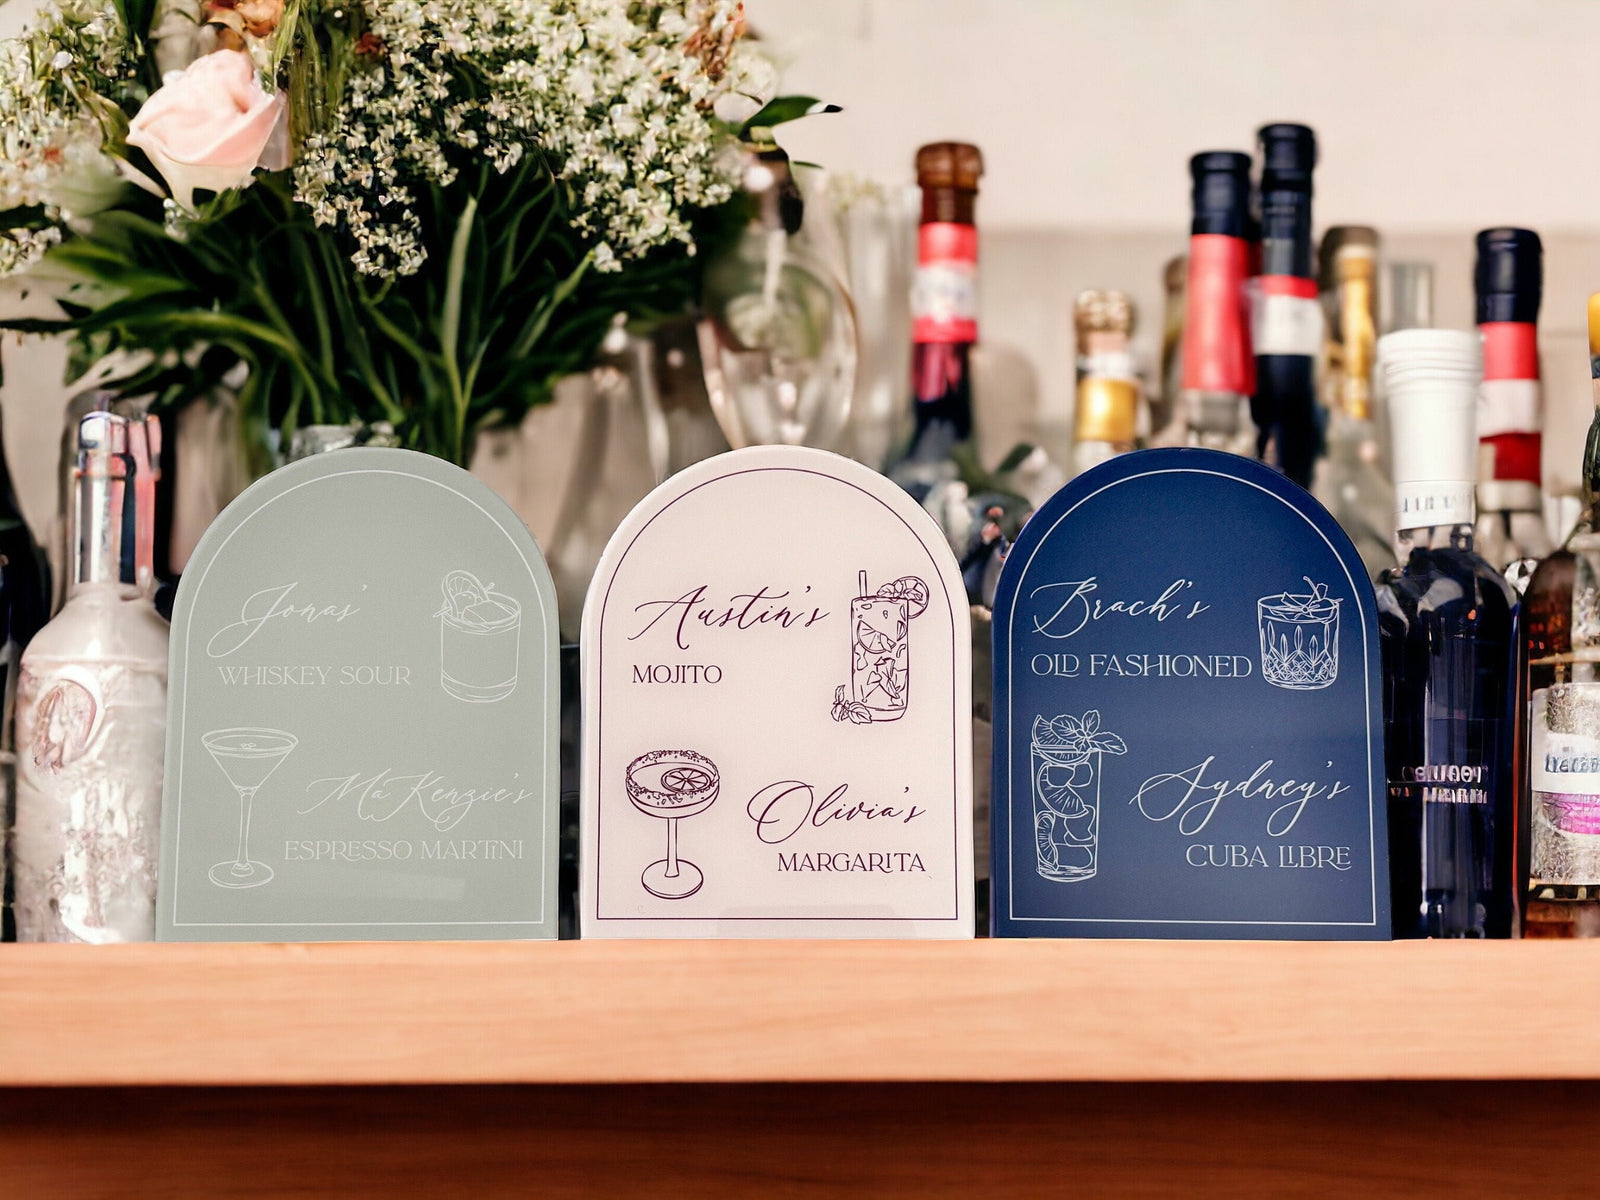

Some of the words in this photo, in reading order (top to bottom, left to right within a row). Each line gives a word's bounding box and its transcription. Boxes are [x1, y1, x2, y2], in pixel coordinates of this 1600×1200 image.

[206, 581, 368, 658] Jonas'
[627, 585, 831, 650] Austin's
[1030, 576, 1210, 639] Brach's
[218, 665, 332, 686] WHISKEY
[340, 665, 412, 686] SOUR
[632, 664, 723, 684] MOJITO
[1031, 653, 1080, 678] OLD
[1089, 654, 1253, 678] FASHIONED
[1128, 755, 1351, 837] Sydney's
[746, 780, 926, 844] Olivia's
[284, 840, 412, 862] ESPRESSO
[420, 840, 523, 860] MARTINI
[778, 852, 926, 874] MARGARITA
[1186, 844, 1269, 868] CUBA
[1278, 845, 1352, 871] LIBRE
